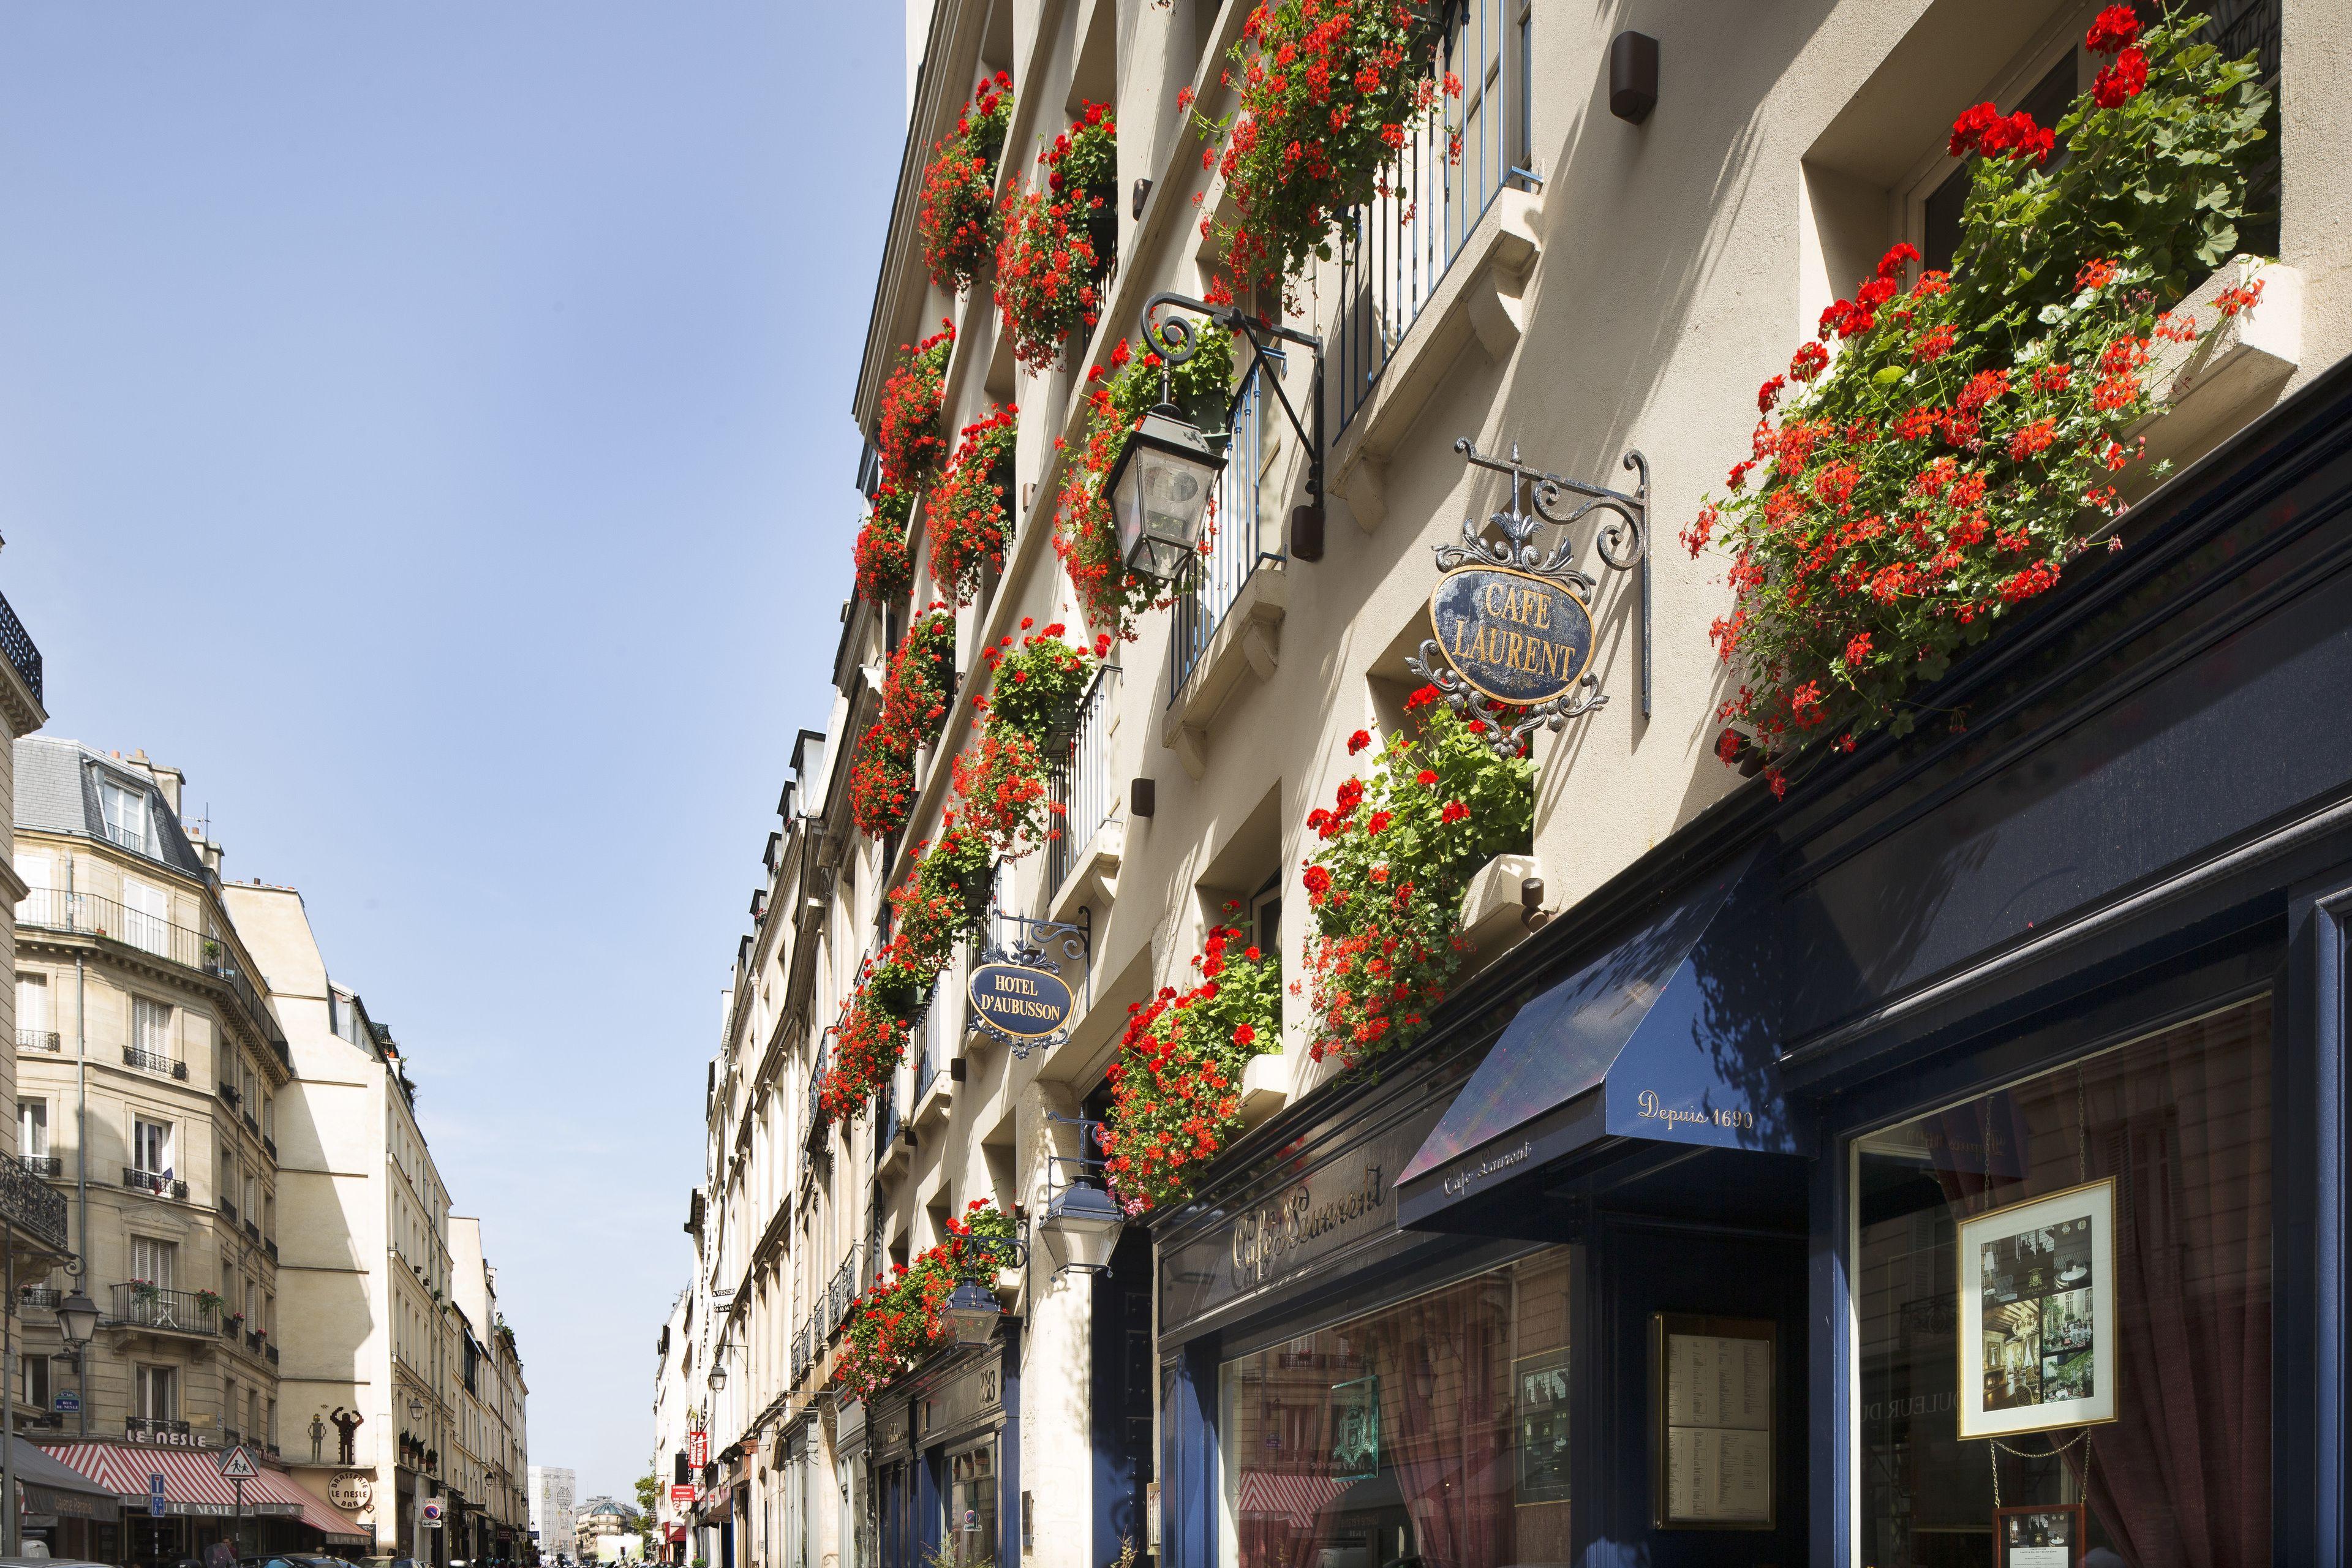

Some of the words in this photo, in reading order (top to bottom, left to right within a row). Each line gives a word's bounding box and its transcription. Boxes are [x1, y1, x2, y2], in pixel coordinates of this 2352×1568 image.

[1485, 582, 1551, 630] CAFE
[1452, 619, 1575, 682] LAURENT
[995, 974, 1038, 997] HOTEL
[981, 993, 1061, 1022] D'AUBUSSON
[1638, 1090, 1709, 1131] Depuis
[1712, 1108, 1753, 1129] 1690
[1476, 1141, 1532, 1177] Laurent
[1280, 1163, 1378, 1243] Laurent
[127, 1430, 145, 1443] LE
[156, 1431, 206, 1447] NESLE
[331, 1473, 368, 1488] BRASSERIE
[173, 1503, 187, 1513] LE
[196, 1504, 232, 1515] NESLE
